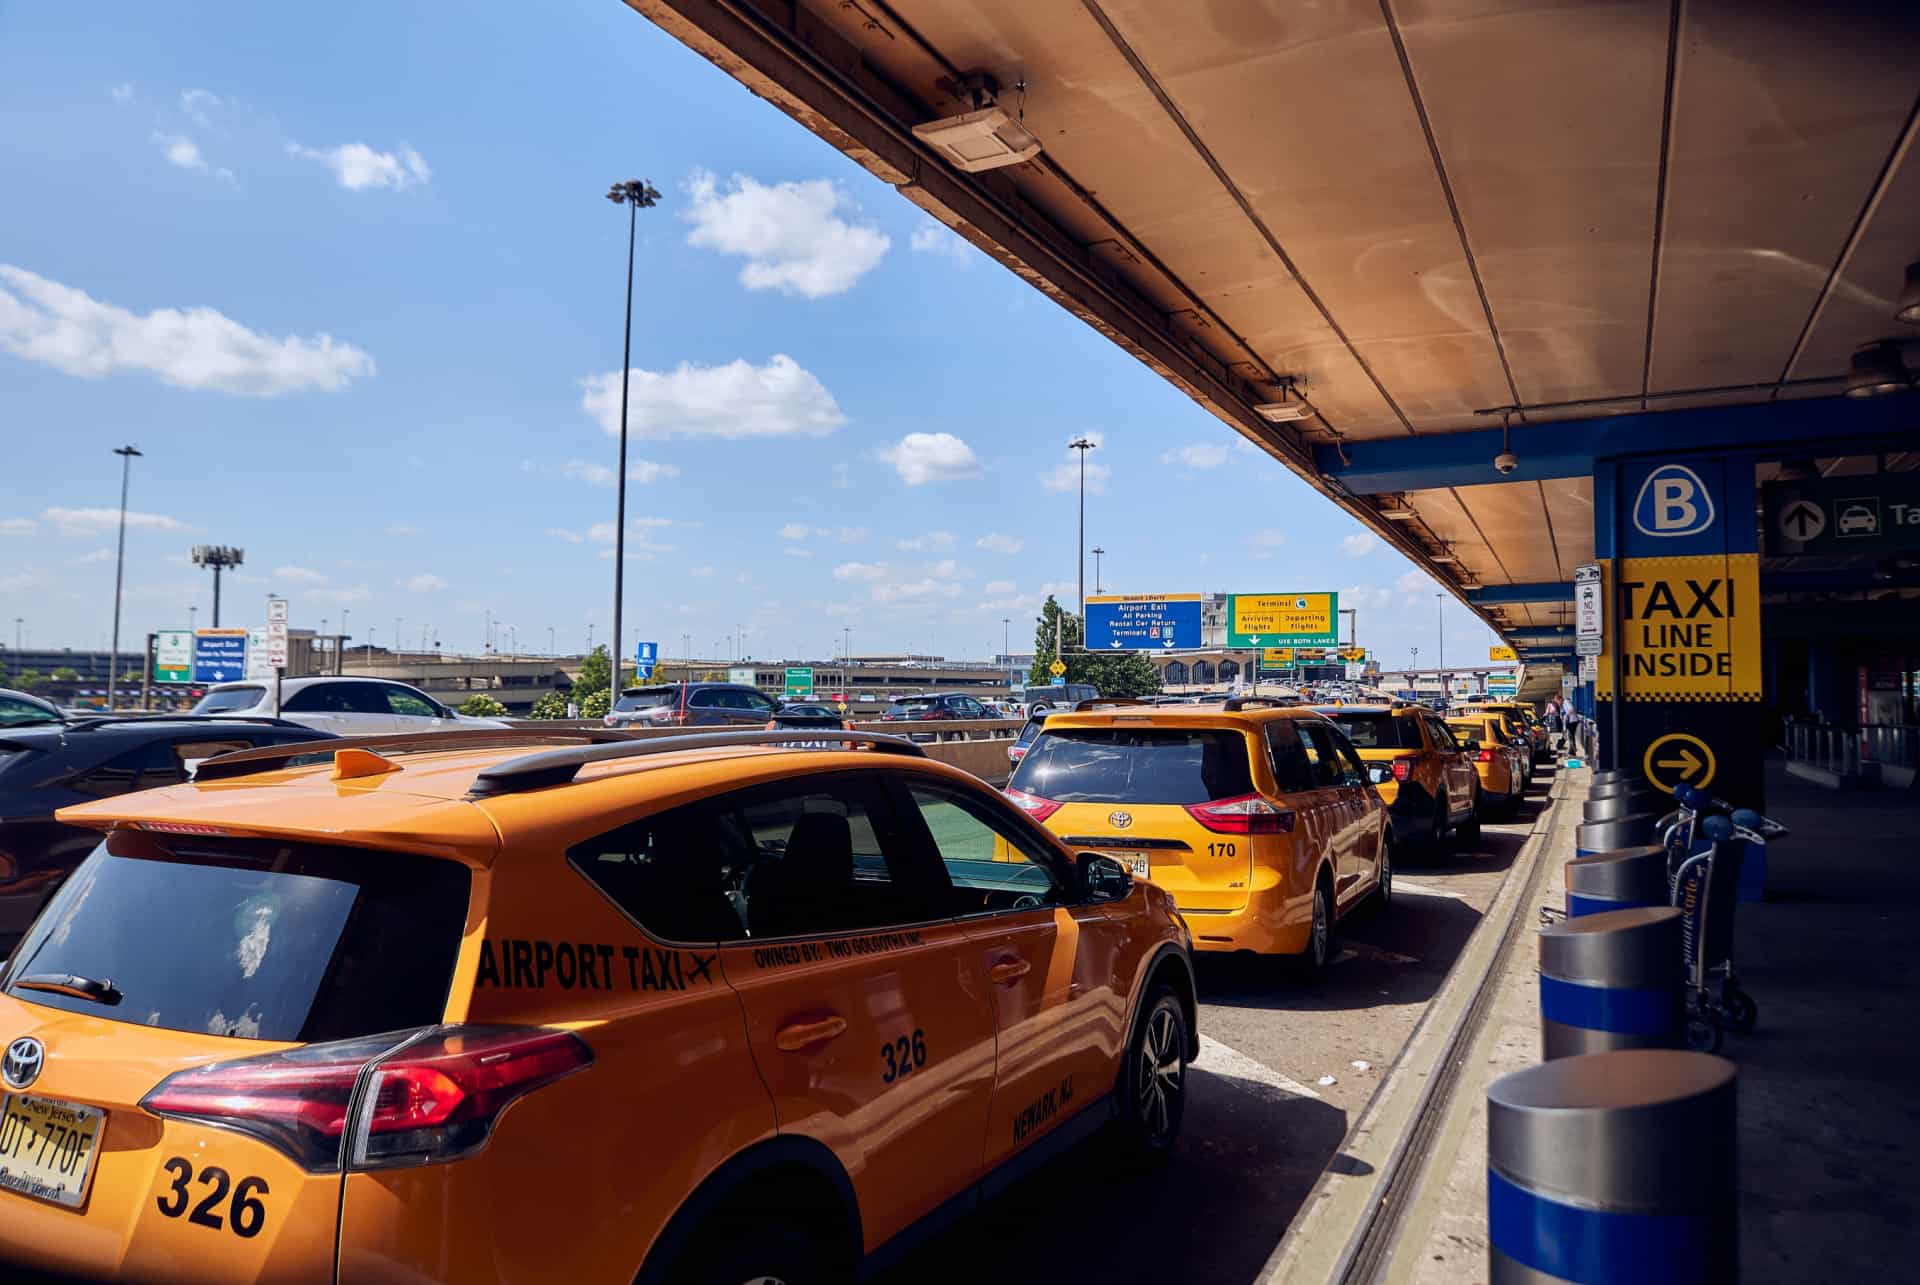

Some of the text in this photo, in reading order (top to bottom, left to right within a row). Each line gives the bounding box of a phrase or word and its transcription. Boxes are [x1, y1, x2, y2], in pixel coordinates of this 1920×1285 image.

[1654, 478, 1697, 529] B
[1119, 603, 1167, 611] Airport Exit
[1619, 579, 1736, 620] TAXI
[1286, 614, 1325, 622] Departing
[1643, 623, 1713, 648] LINE
[1623, 653, 1732, 677] INSIDE
[1208, 843, 1236, 857] 170
[475, 938, 687, 991] AIRPORT TAXI
[754, 944, 801, 969] OWNED
[801, 943, 822, 962] BY:
[824, 939, 852, 959] TWO
[881, 1028, 926, 1084] 326
[156, 1156, 270, 1239] 326
